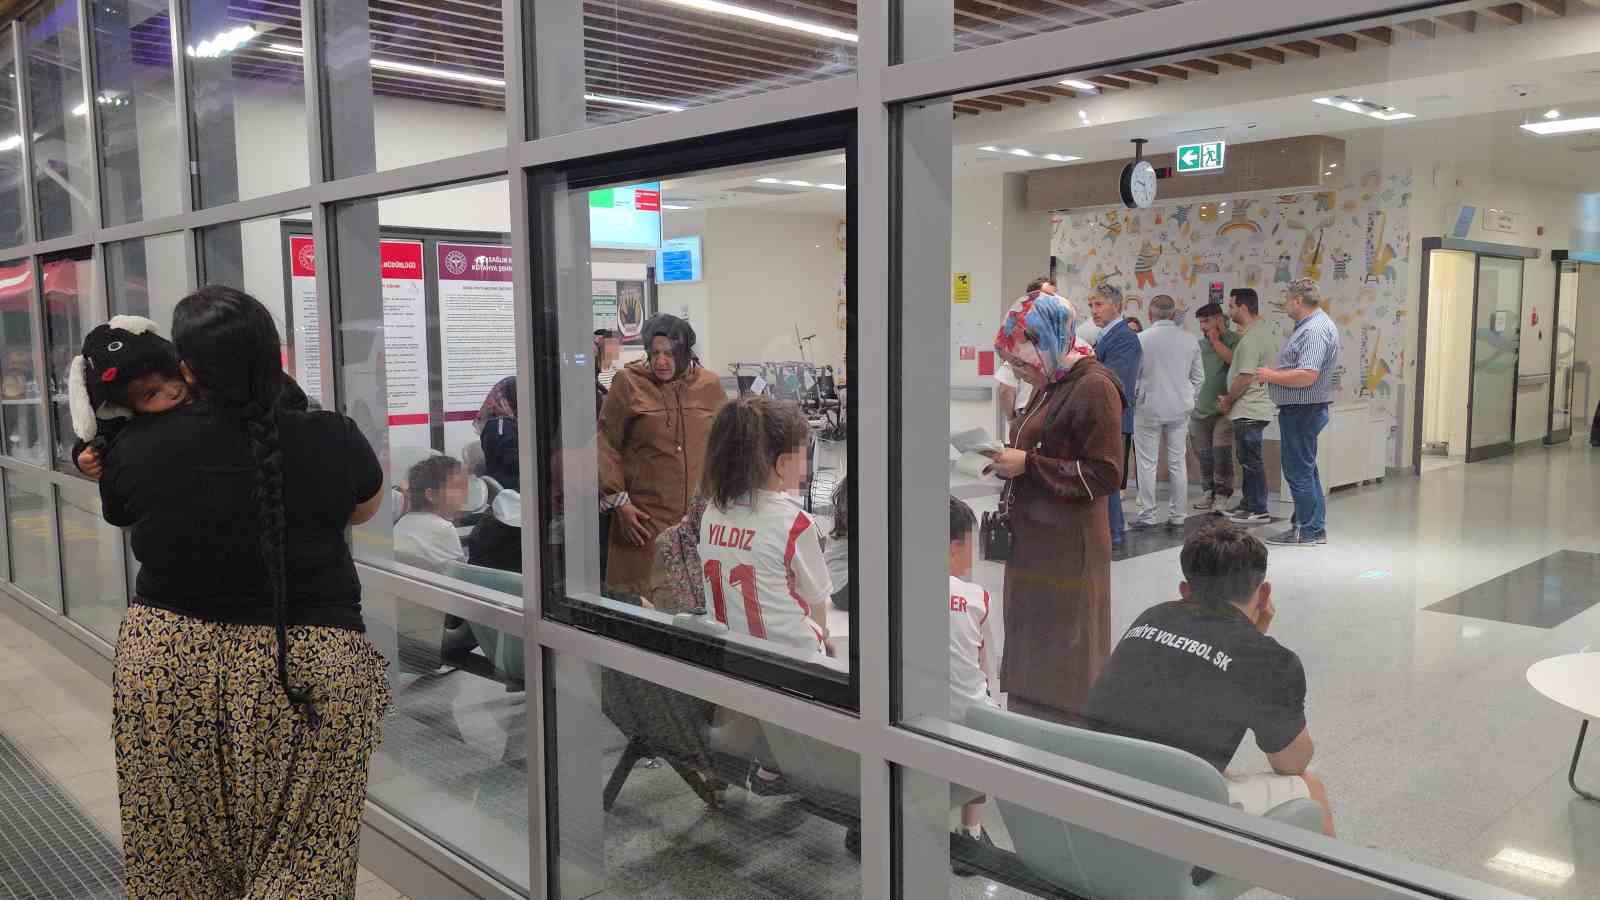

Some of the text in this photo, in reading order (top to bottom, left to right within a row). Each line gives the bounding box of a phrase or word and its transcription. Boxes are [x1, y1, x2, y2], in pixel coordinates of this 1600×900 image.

[708, 523, 756, 551] YILDIZ
[702, 559, 767, 641] 11
[1155, 631, 1212, 660] VOLEYBOL
[1213, 651, 1232, 671] SK
